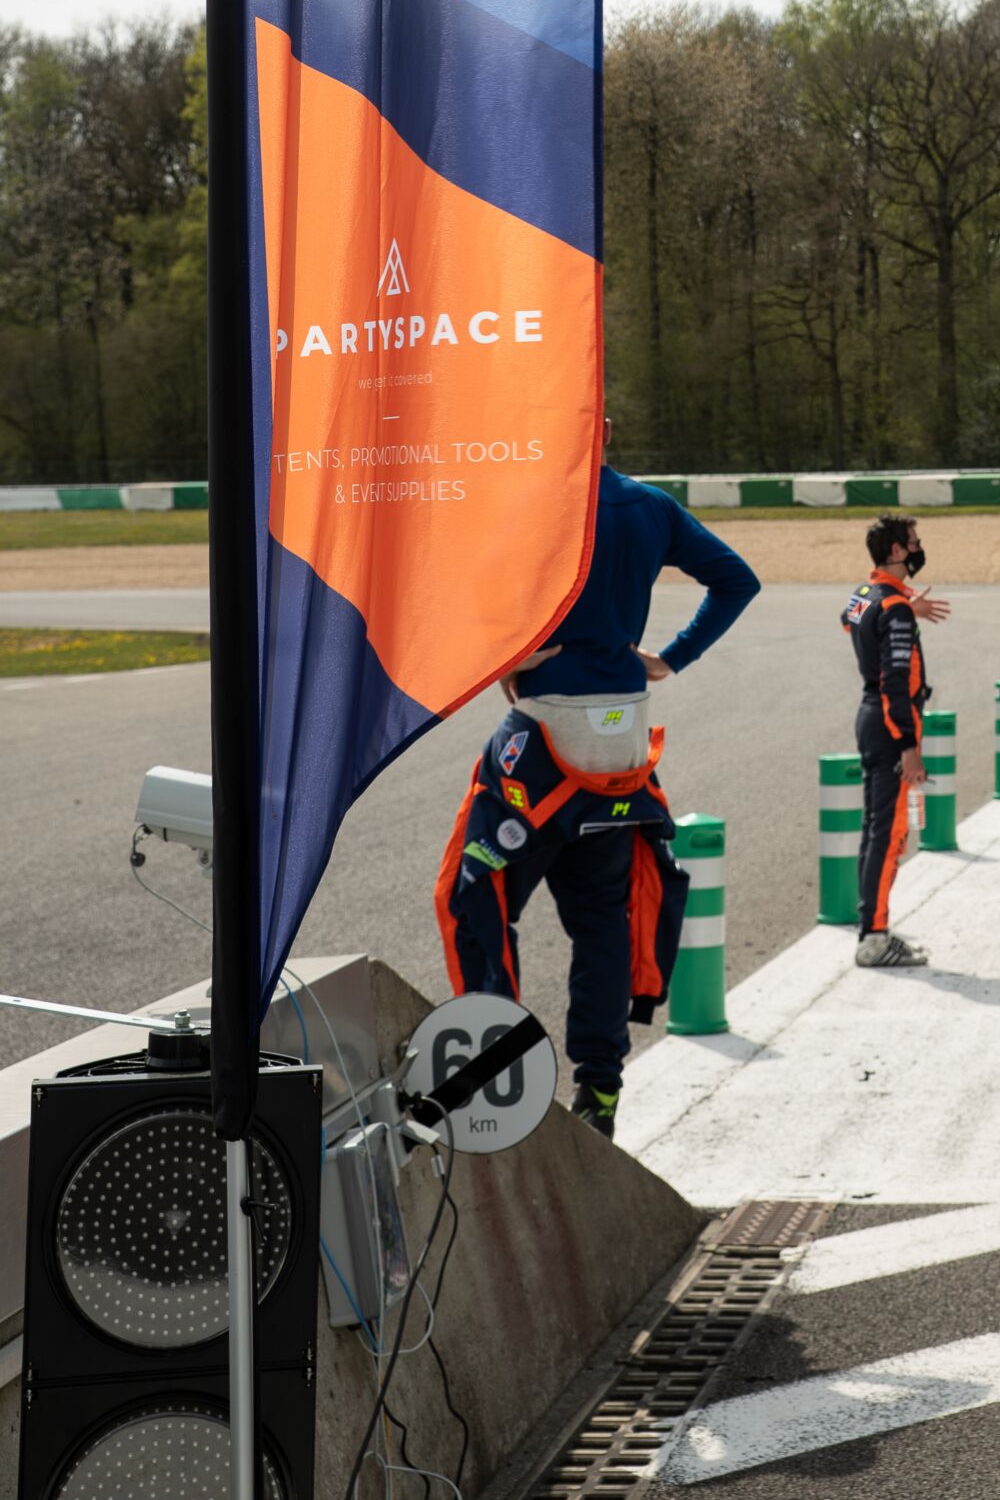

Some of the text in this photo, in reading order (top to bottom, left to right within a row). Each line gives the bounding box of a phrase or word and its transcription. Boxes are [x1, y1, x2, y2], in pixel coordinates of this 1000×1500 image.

[275, 309, 544, 359] PARTYSPACE
[394, 370, 433, 387] covered
[273, 439, 544, 474] TENTS, PROMOTIONAL TOOLS
[334, 479, 467, 504] & EVENT SUPPLIES
[431, 1023, 525, 1110] 60
[468, 1115, 498, 1133] km
